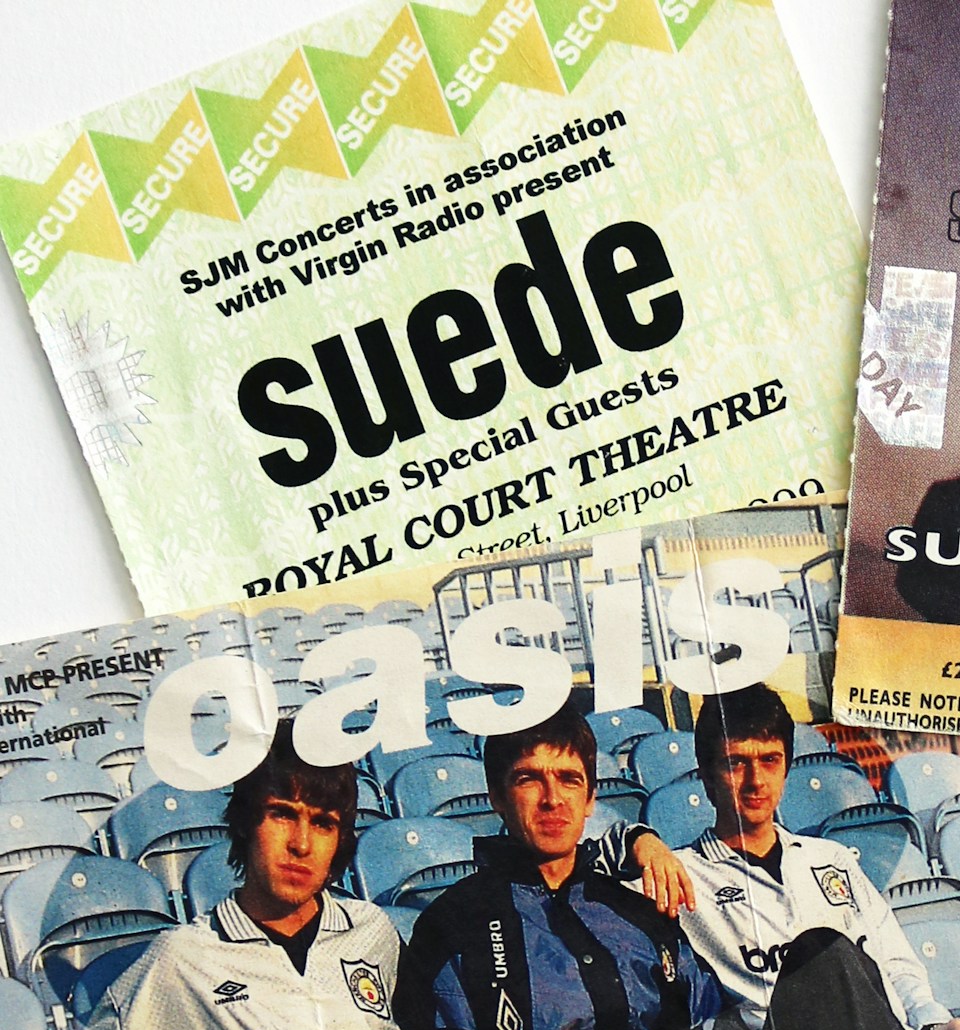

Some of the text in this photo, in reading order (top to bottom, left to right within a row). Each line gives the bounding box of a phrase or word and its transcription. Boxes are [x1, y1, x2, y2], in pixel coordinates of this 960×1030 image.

[228, 78, 319, 192] SECURE
[336, 35, 426, 150] SECURE
[12, 161, 102, 276] SECURE
[121, 117, 211, 234] SECURE
[179, 109, 627, 295] SJM Concerts in association
[215, 146, 616, 318] with Virgin Radio present
[237, 210, 684, 487] suede
[308, 367, 679, 534] plus Special Guests
[404, 380, 787, 547] COURT THEATRE
[557, 463, 694, 536] Liverpool
[143, 535, 792, 792] oasis
[849, 686, 912, 708] PLEASE
[489, 920, 508, 979] UMBRO
